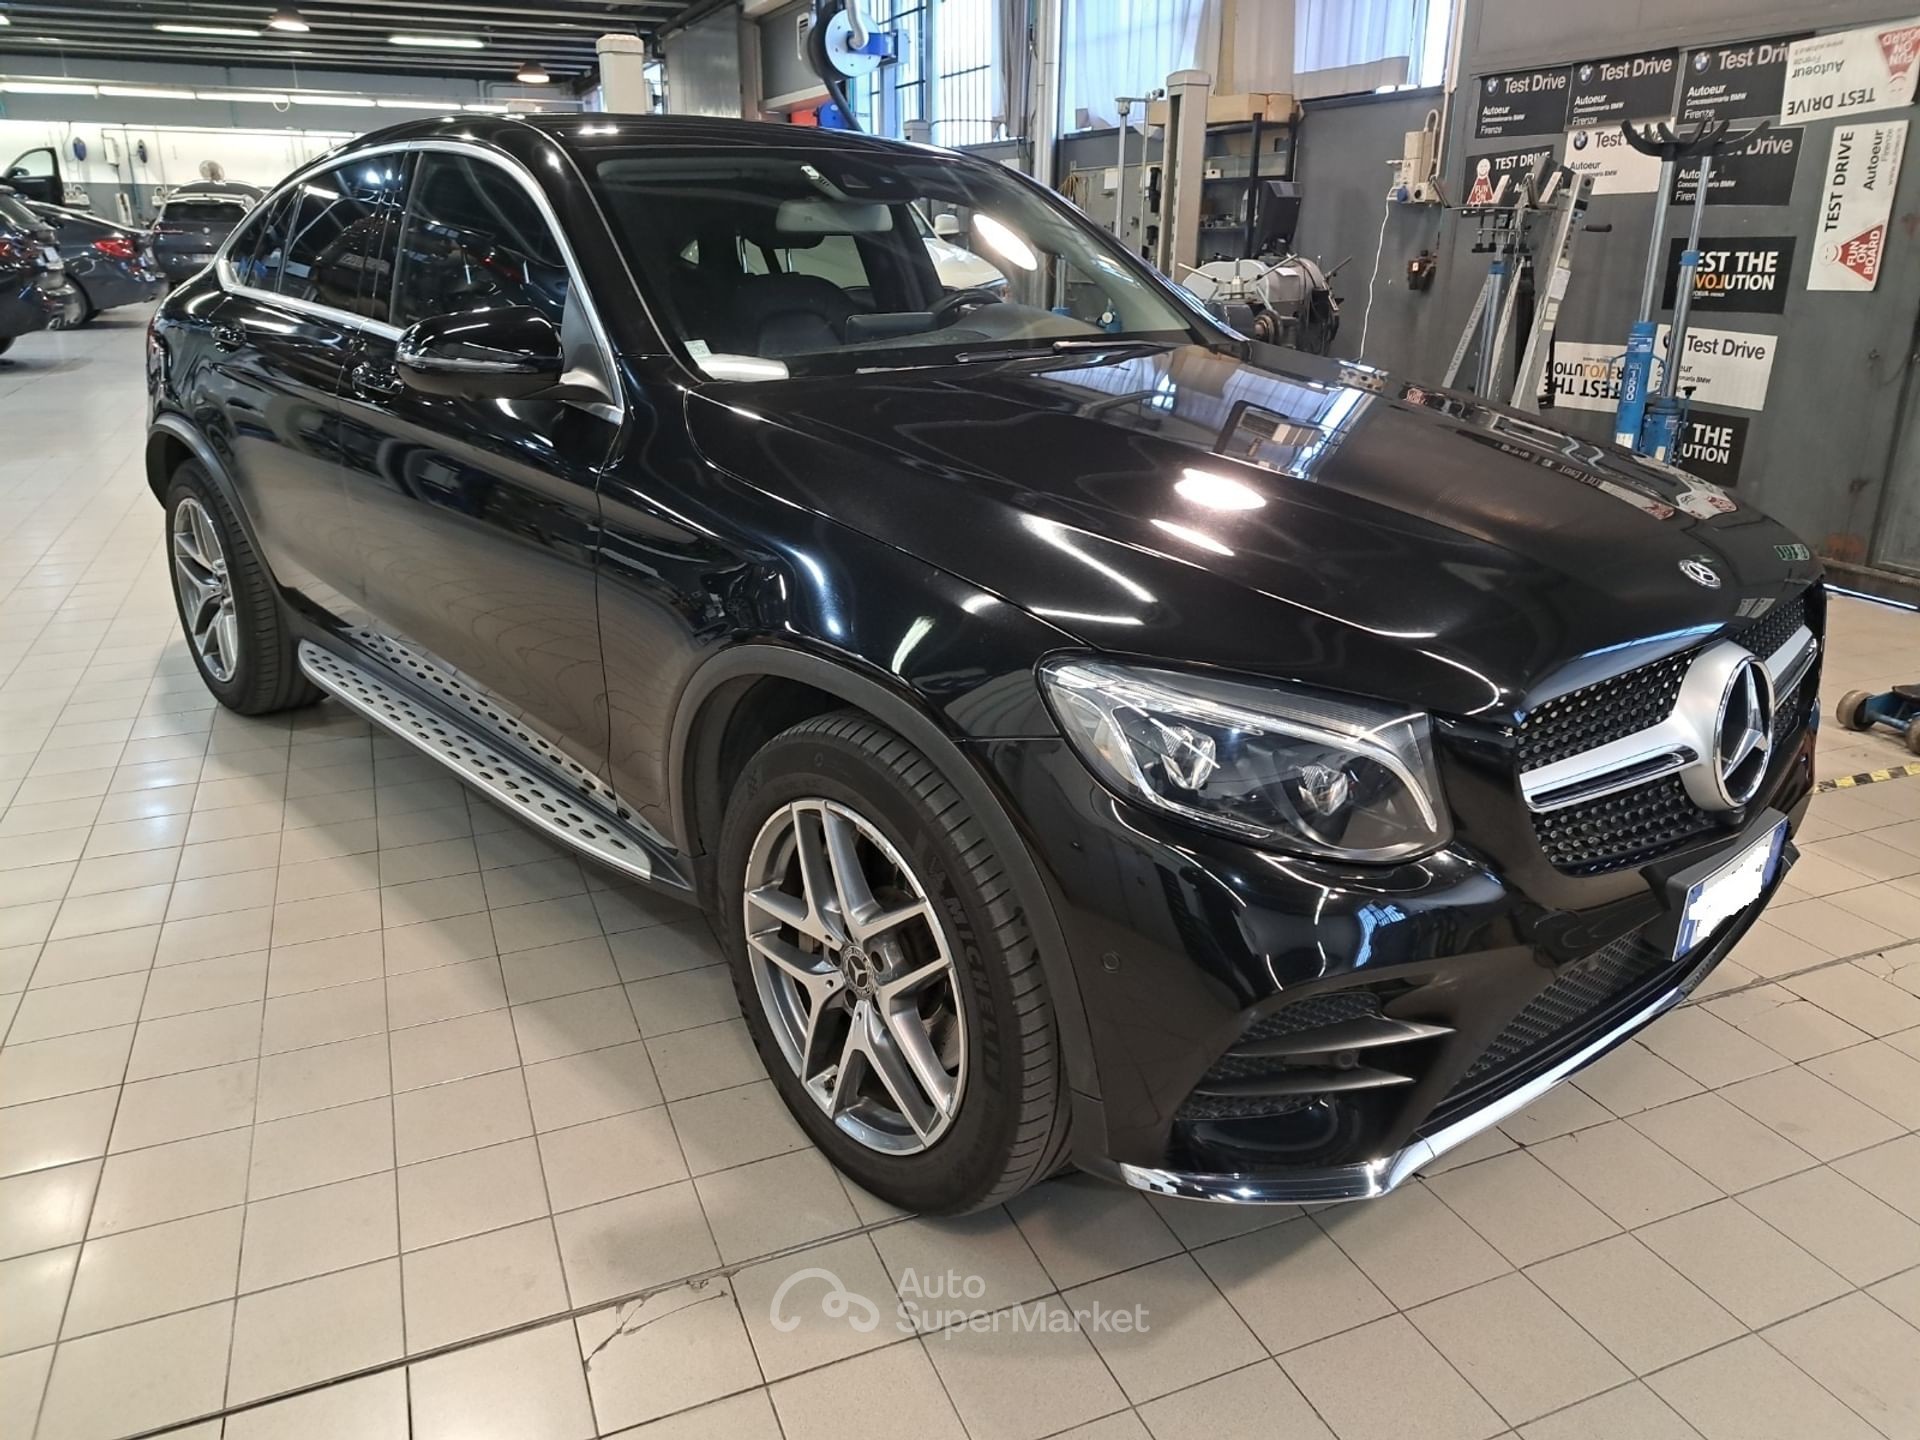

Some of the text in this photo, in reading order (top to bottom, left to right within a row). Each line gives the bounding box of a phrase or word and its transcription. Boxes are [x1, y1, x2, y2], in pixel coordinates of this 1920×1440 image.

[1719, 42, 1789, 70] Test Dri
[1600, 56, 1672, 81] Test Drive
[1792, 59, 1845, 78] Autoeur
[1504, 73, 1566, 94] Test Drive
[1687, 85, 1727, 97] Autoeur
[1574, 94, 1607, 105] Autoeur
[1787, 87, 1876, 116] TEST DRIVE
[1482, 106, 1510, 115] Autoeur
[1684, 109, 1715, 119] Firenze
[1595, 131, 1623, 149] Test
[1495, 155, 1518, 170] TEST
[1570, 161, 1601, 170] Autoeur
[1863, 129, 1884, 191] Autoeur
[1679, 168, 1717, 180] Autour
[1824, 131, 1855, 233] TEST DRIVE
[1675, 190, 1696, 201] Firen
[1696, 251, 1779, 273] EST THE
[1846, 241, 1860, 266] FUN
[1856, 243, 1868, 263] ON
[1863, 230, 1880, 274] BOARD
[1687, 335, 1765, 360] Test Drive
[1692, 423, 1733, 448] THE
[1682, 442, 1730, 465] UTION
[946, 896, 1002, 1092] MICHELIN
